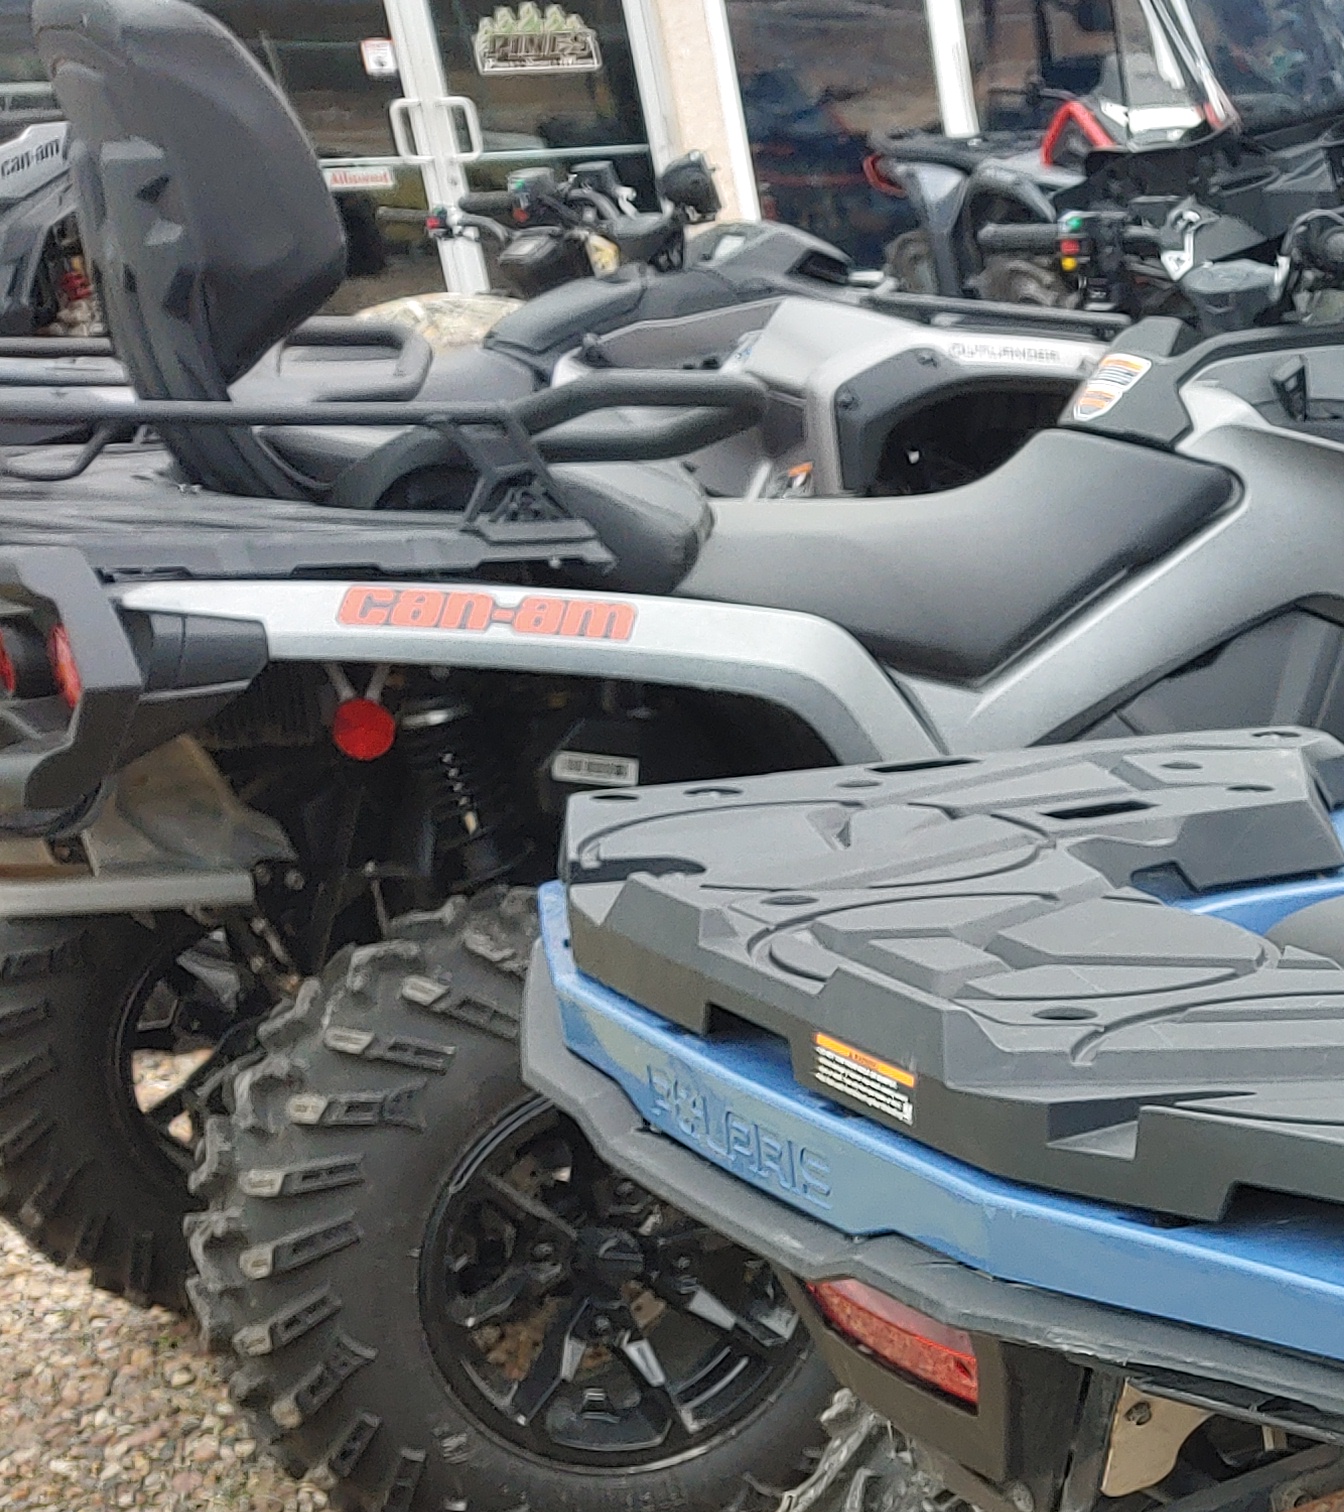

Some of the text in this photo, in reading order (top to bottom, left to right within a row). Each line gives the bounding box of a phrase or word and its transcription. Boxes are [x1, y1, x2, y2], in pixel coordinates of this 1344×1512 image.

[1, 138, 60, 176] can-am
[338, 583, 637, 641] can-am
[646, 1065, 832, 1211] POLARIS
